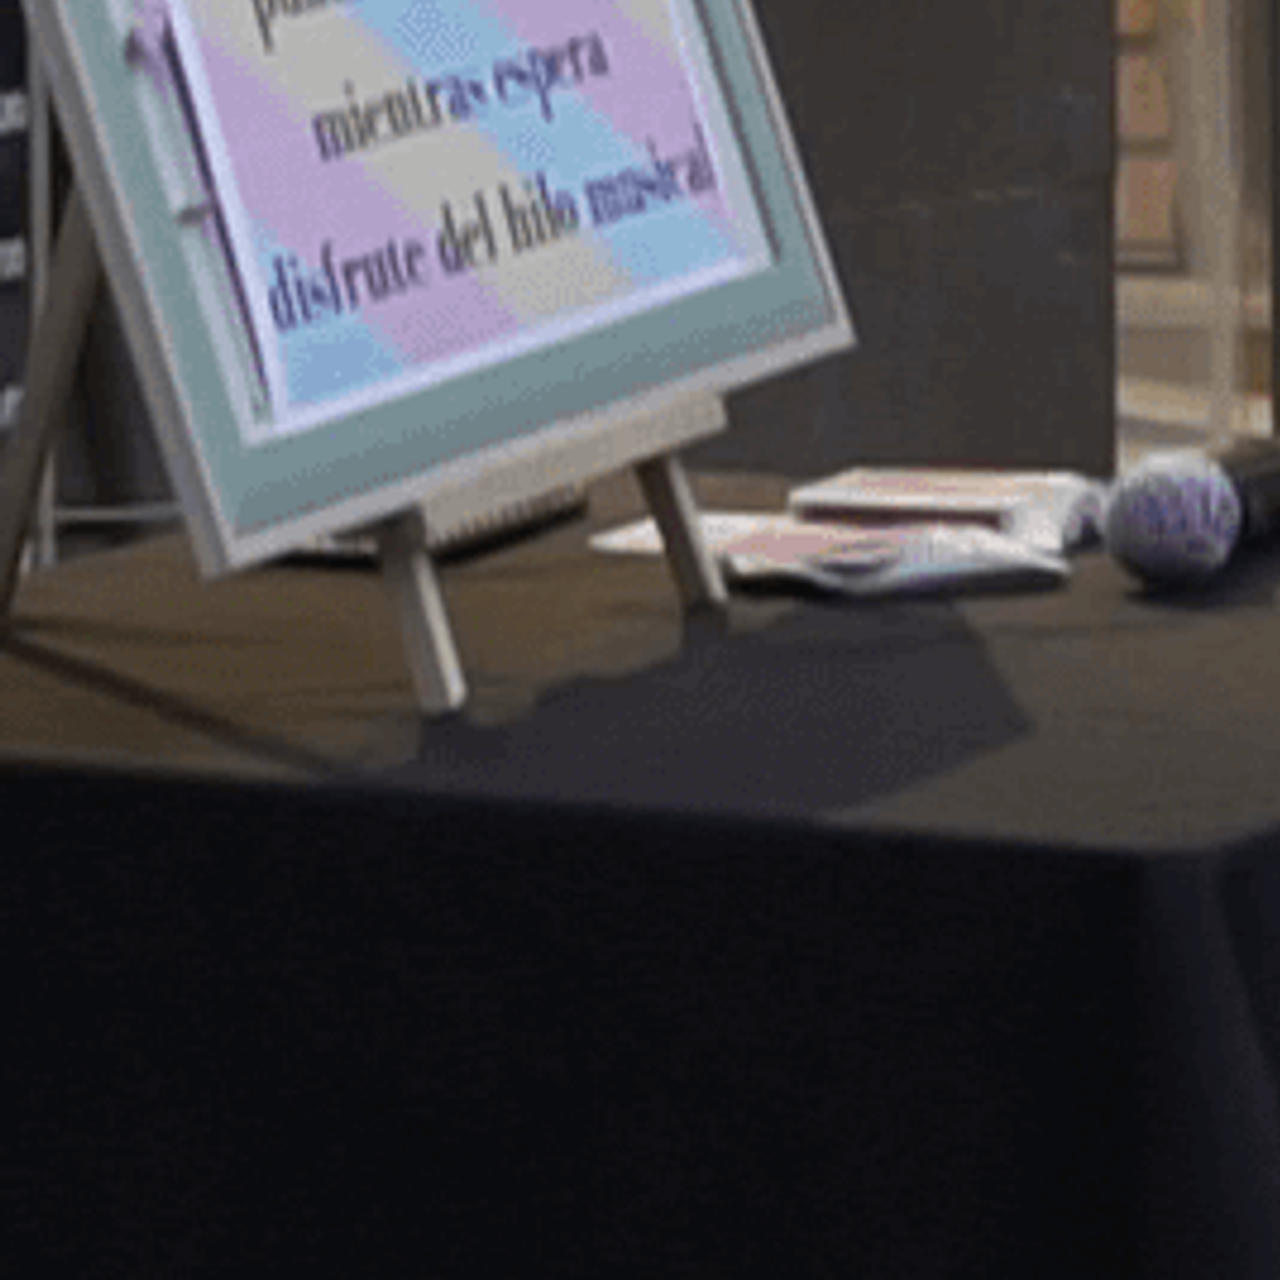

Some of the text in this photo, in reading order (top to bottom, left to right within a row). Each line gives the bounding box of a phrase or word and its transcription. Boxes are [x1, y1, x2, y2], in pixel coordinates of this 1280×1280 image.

[311, 28, 610, 163] mientras espera
[267, 236, 427, 332] disfrute
[436, 196, 499, 279] del
[497, 168, 580, 256] hilo
